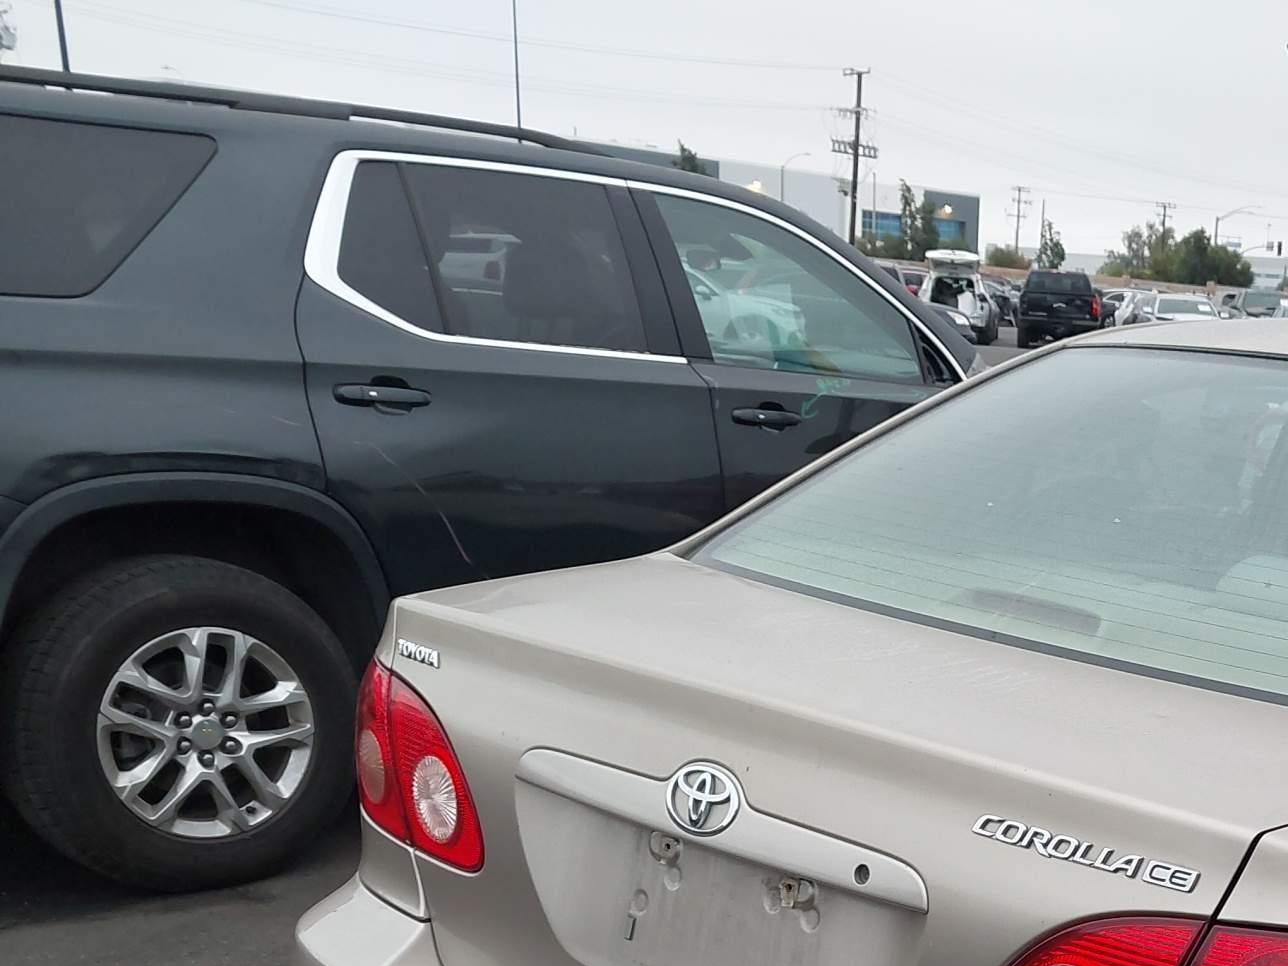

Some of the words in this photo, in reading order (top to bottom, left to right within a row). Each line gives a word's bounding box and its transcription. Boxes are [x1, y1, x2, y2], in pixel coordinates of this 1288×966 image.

[398, 638, 440, 669] TOYOTA
[971, 814, 1144, 878] COROLLA
[1146, 862, 1195, 890] CE
